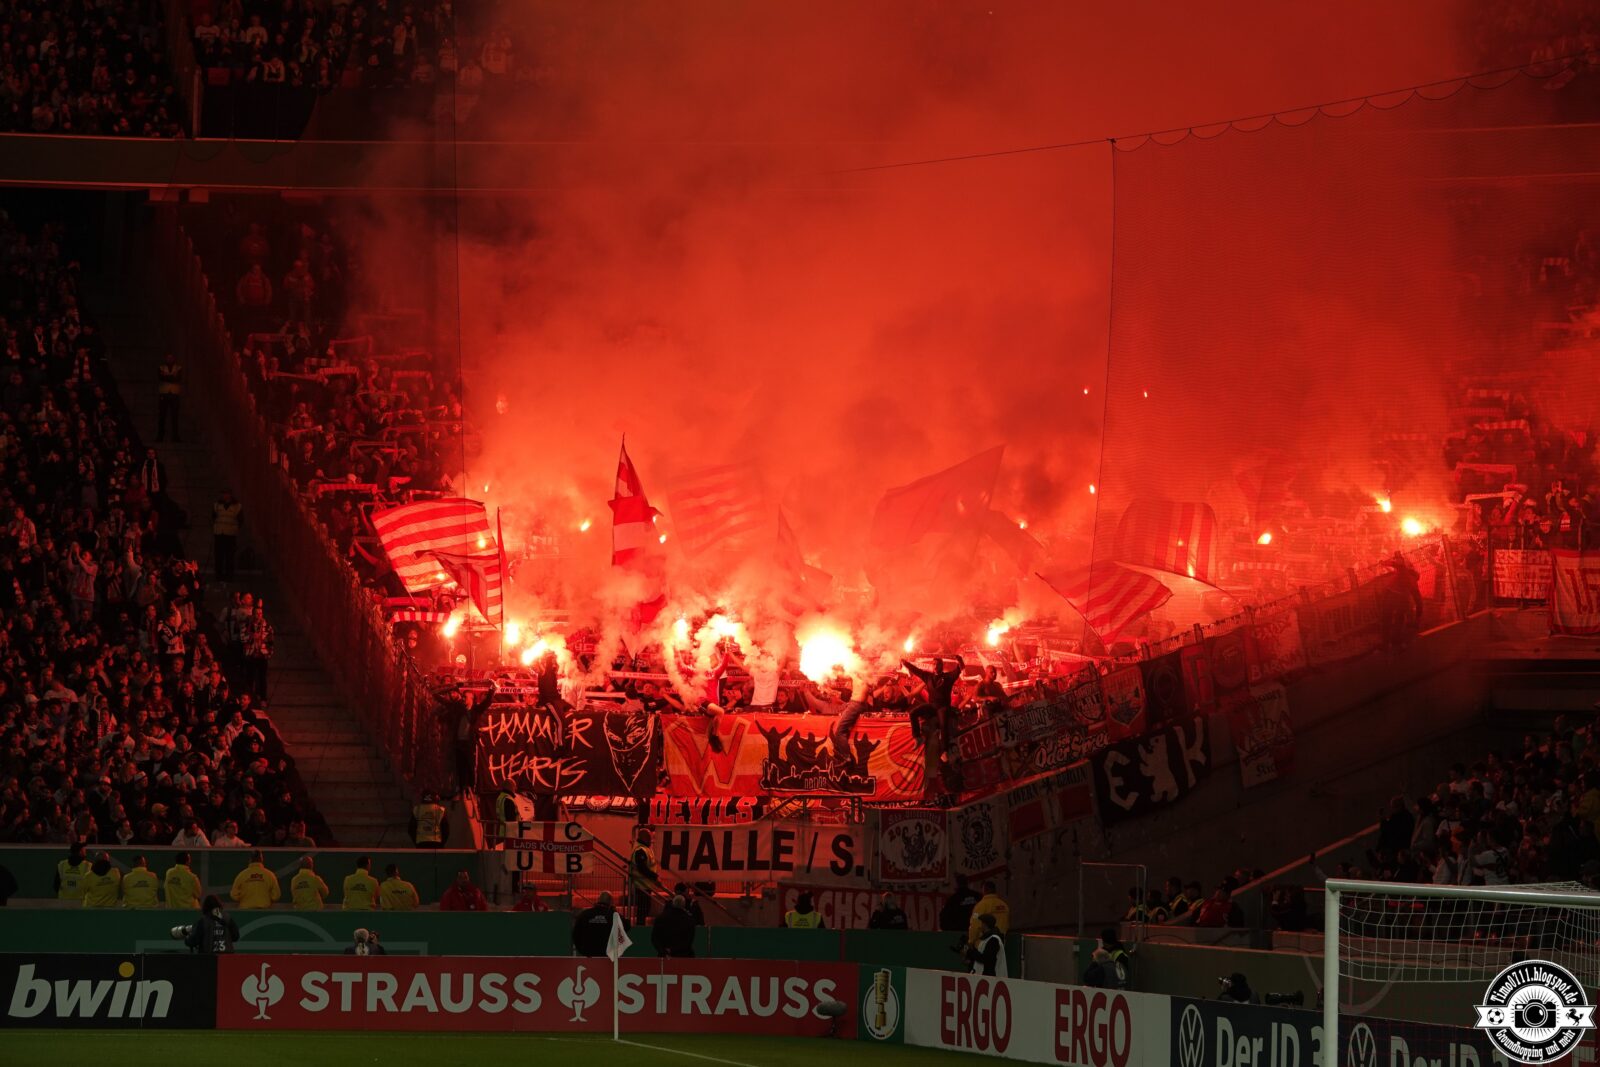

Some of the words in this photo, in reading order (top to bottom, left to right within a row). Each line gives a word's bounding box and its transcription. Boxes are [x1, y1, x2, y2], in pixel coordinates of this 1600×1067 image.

[488, 750, 588, 791] HEARTS
[564, 822, 582, 841] C
[649, 796, 759, 825] DEVILS
[513, 839, 537, 851] LADS
[539, 840, 585, 853] KÖPENICK
[516, 851, 534, 871] U
[566, 853, 583, 873] B
[661, 830, 795, 872] HALLE
[829, 833, 865, 877] S.
[7, 960, 175, 1019] bwin
[299, 970, 543, 1015] STRAUSS
[617, 973, 838, 1020] STRAUSS
[940, 975, 1012, 1053] ERGO
[1054, 988, 1132, 1067] ERGO
